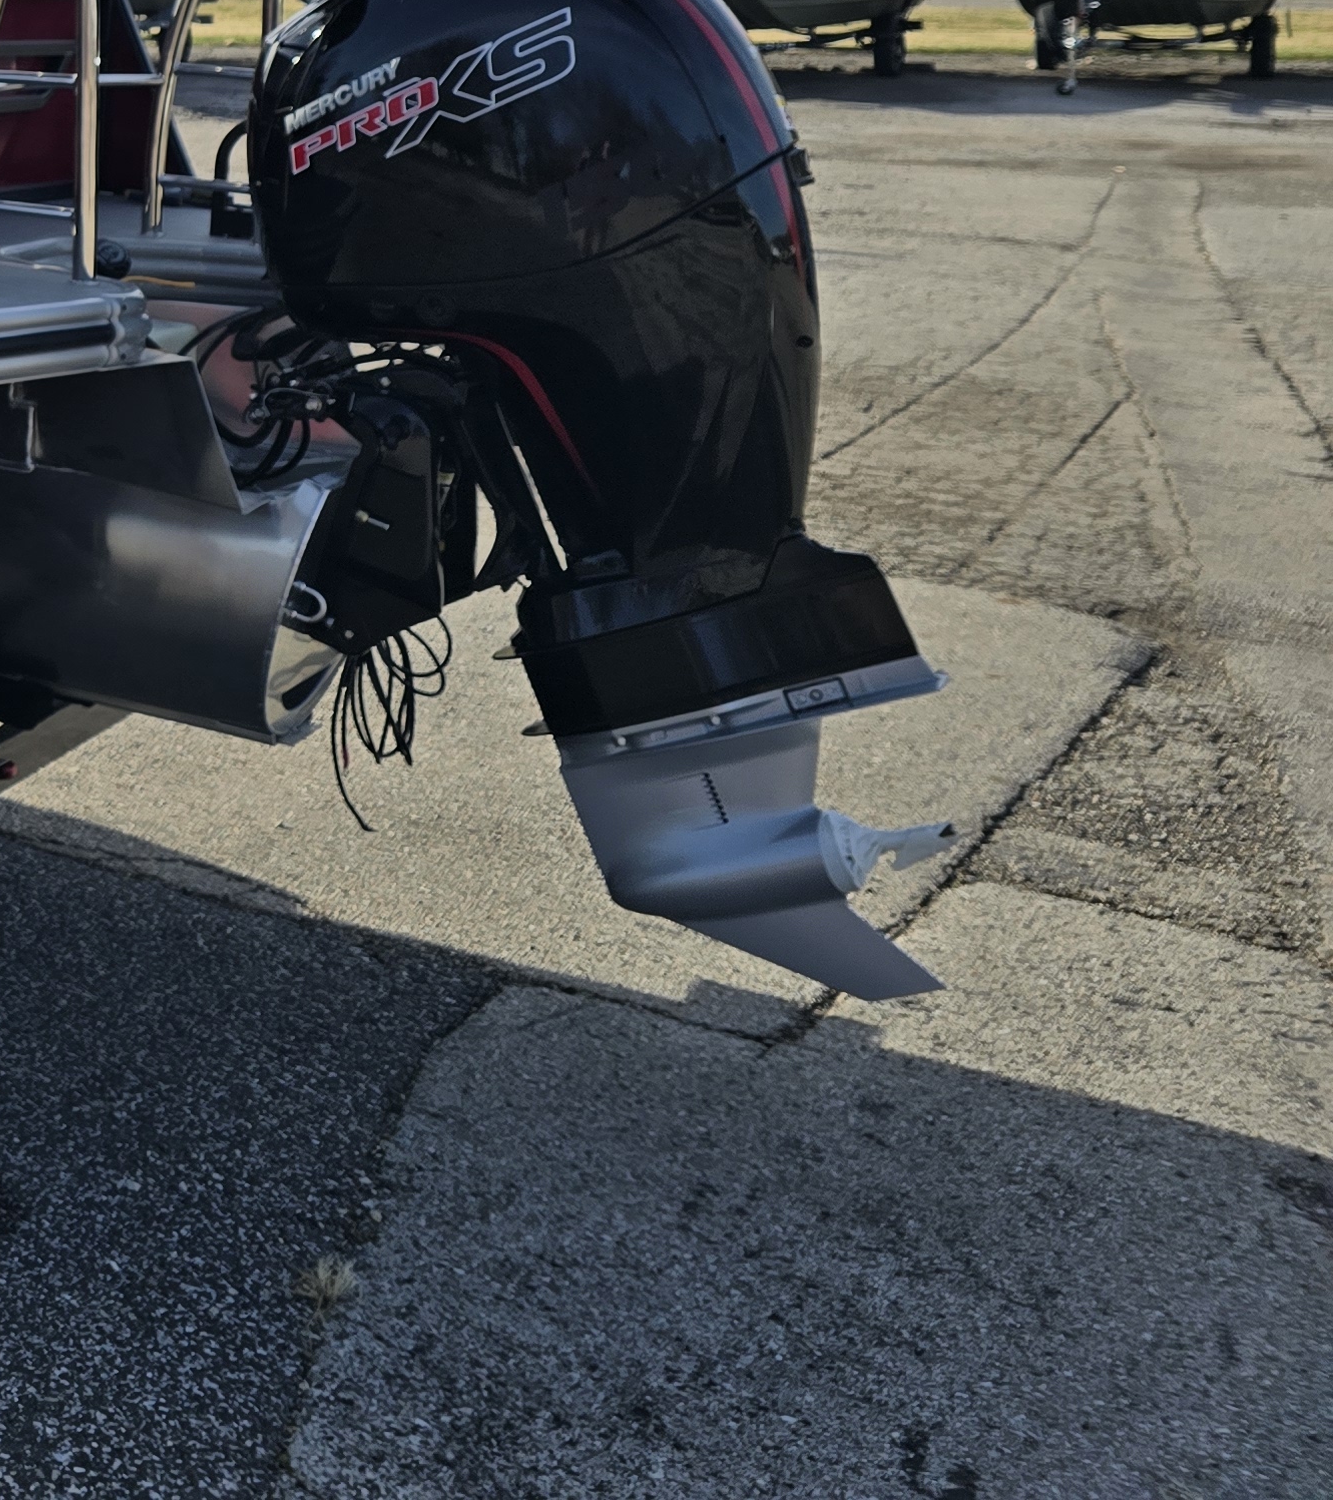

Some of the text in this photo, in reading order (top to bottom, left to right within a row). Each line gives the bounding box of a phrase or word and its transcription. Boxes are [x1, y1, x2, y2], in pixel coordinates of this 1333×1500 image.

[284, 56, 401, 135] MERCURY
[290, 6, 577, 176] PRO XS
